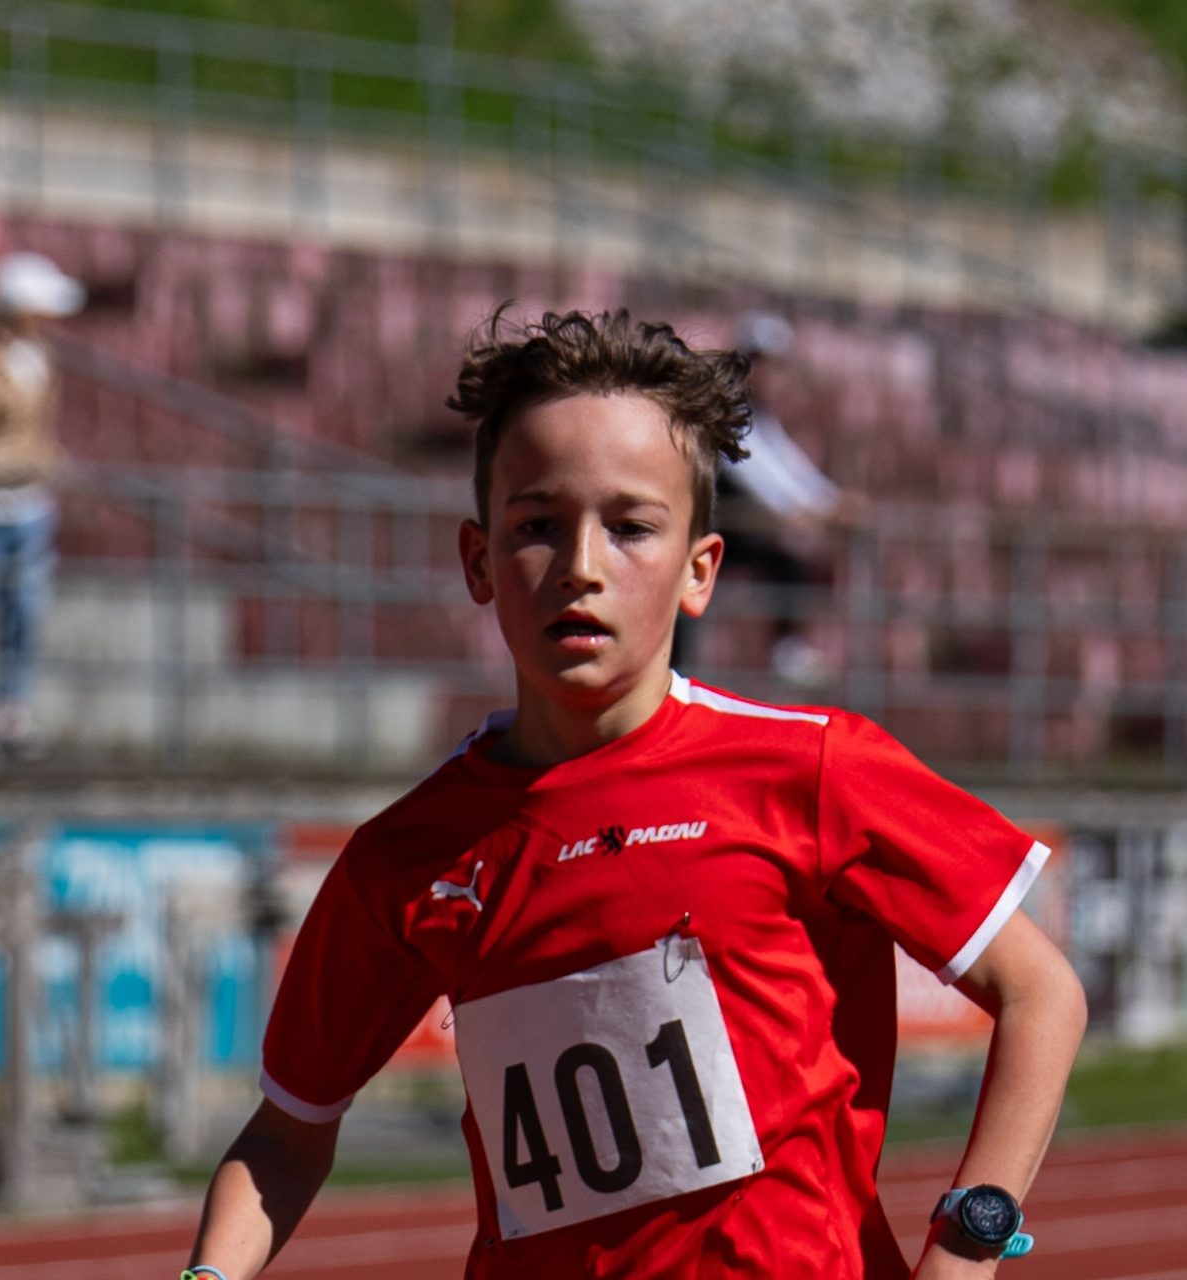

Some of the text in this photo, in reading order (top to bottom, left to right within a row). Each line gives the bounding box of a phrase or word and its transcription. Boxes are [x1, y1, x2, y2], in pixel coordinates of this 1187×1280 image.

[557, 821, 707, 862] LAC PASSAU
[502, 1018, 722, 1213] 401
